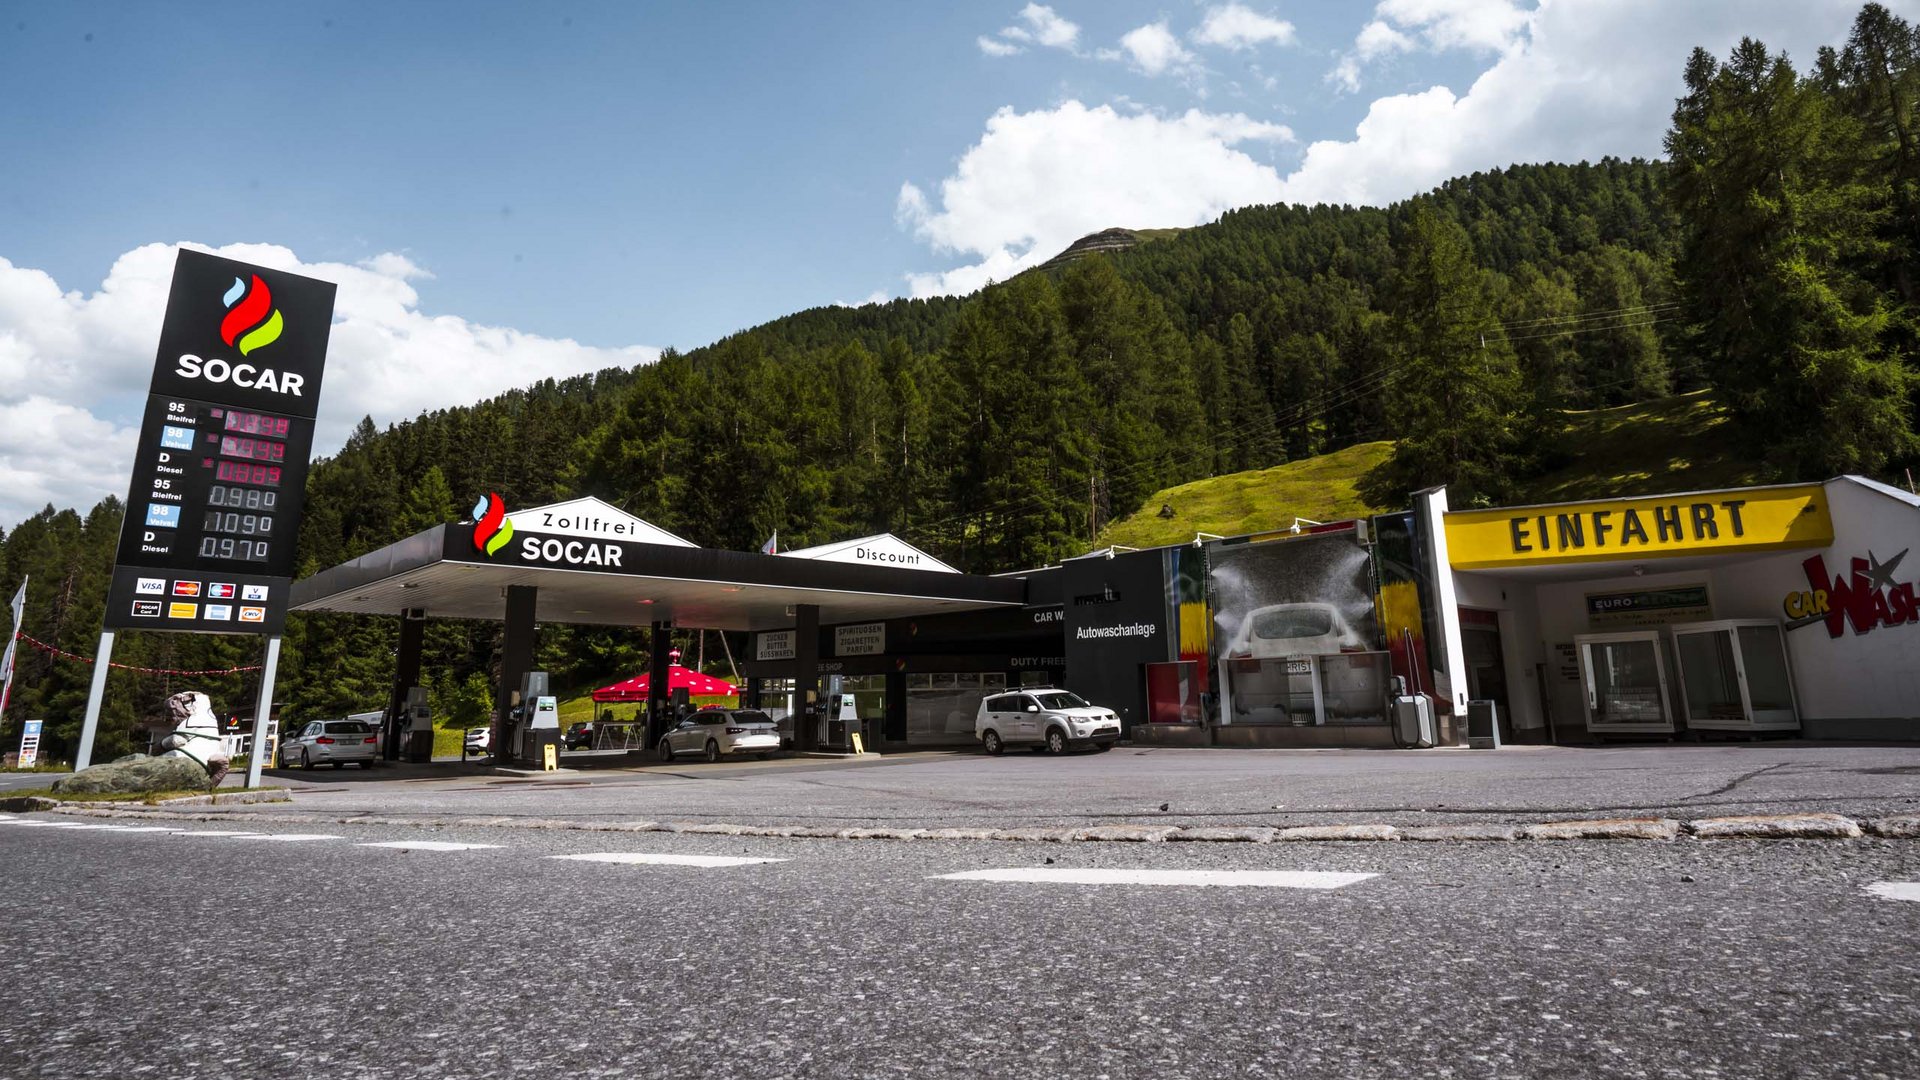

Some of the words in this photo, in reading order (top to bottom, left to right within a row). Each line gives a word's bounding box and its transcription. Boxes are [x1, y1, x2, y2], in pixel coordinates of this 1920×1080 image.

[175, 354, 304, 397] SOCAR
[168, 402, 185, 413] 95
[166, 414, 196, 424] Bleifrei
[167, 428, 183, 438] 98
[165, 440, 189, 449] Velvet
[159, 452, 170, 463] D
[157, 465, 183, 474] Diesel
[153, 479, 171, 490] 95
[152, 491, 182, 501] Bleifrei
[210, 485, 276, 509] 0.980
[152, 505, 169, 516] 98
[150, 518, 175, 527] Velvet
[215, 511, 272, 534] 1.090
[543, 513, 635, 535] Zollfrei
[1510, 500, 1747, 552] EINFAHRT
[143, 531, 155, 542] D
[141, 545, 169, 553] Diesel
[201, 537, 268, 560] 0.970
[521, 536, 623, 567] SOCAR
[857, 547, 920, 565] Discount
[1595, 598, 1633, 608] EURO
[1784, 588, 1831, 620] CAR
[1034, 612, 1053, 623] CAR
[1076, 622, 1156, 640] Autowaschanlage
[840, 636, 880, 646] ZIGARETTEN
[825, 662, 844, 671] SHOP
[1011, 657, 1038, 667] DUTY
